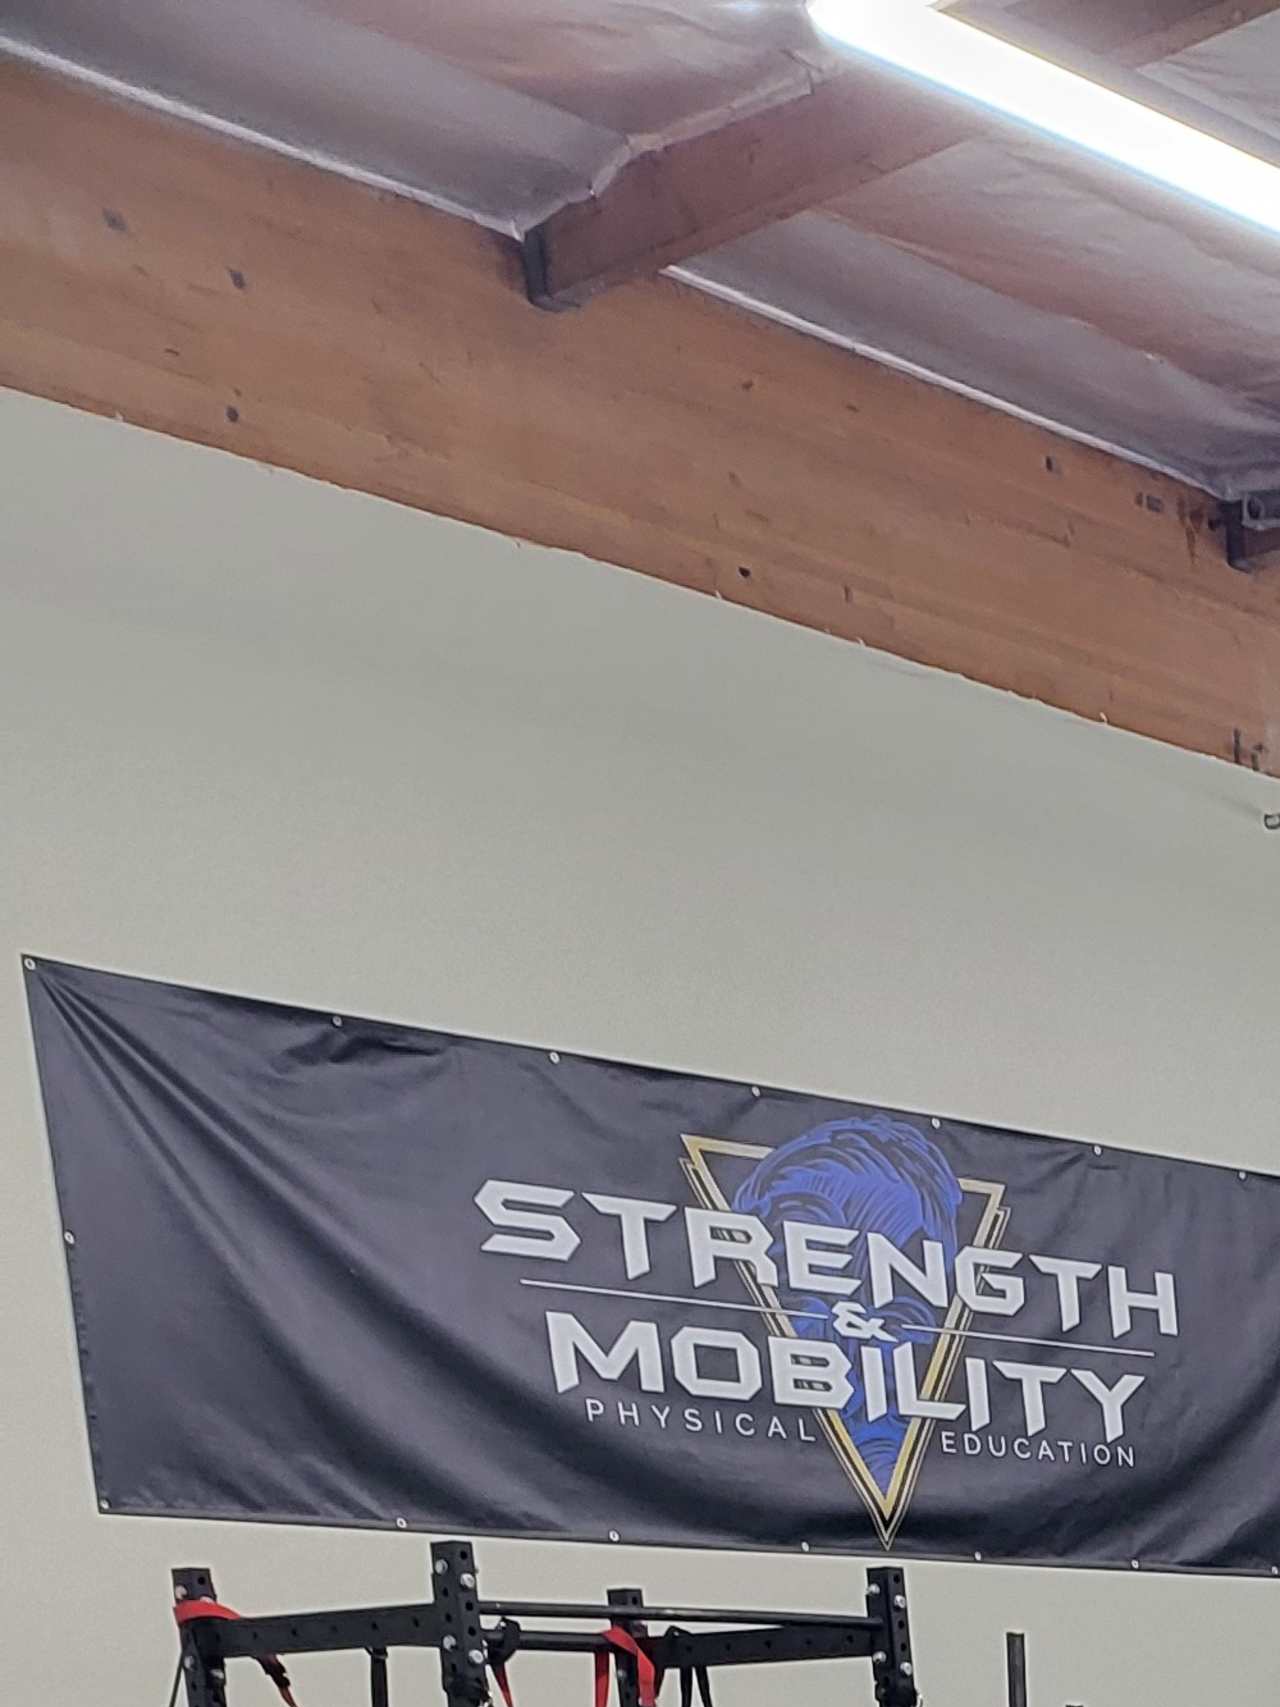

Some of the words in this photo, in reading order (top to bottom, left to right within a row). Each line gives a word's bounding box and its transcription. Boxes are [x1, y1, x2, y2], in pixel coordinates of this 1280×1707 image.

[474, 1179, 1180, 1338] STRENGTH
[828, 1302, 899, 1343] &
[545, 1311, 1145, 1444] MOBILITY
[585, 1399, 816, 1442] PHYSICAL
[941, 1430, 1136, 1468] EDUCATION
